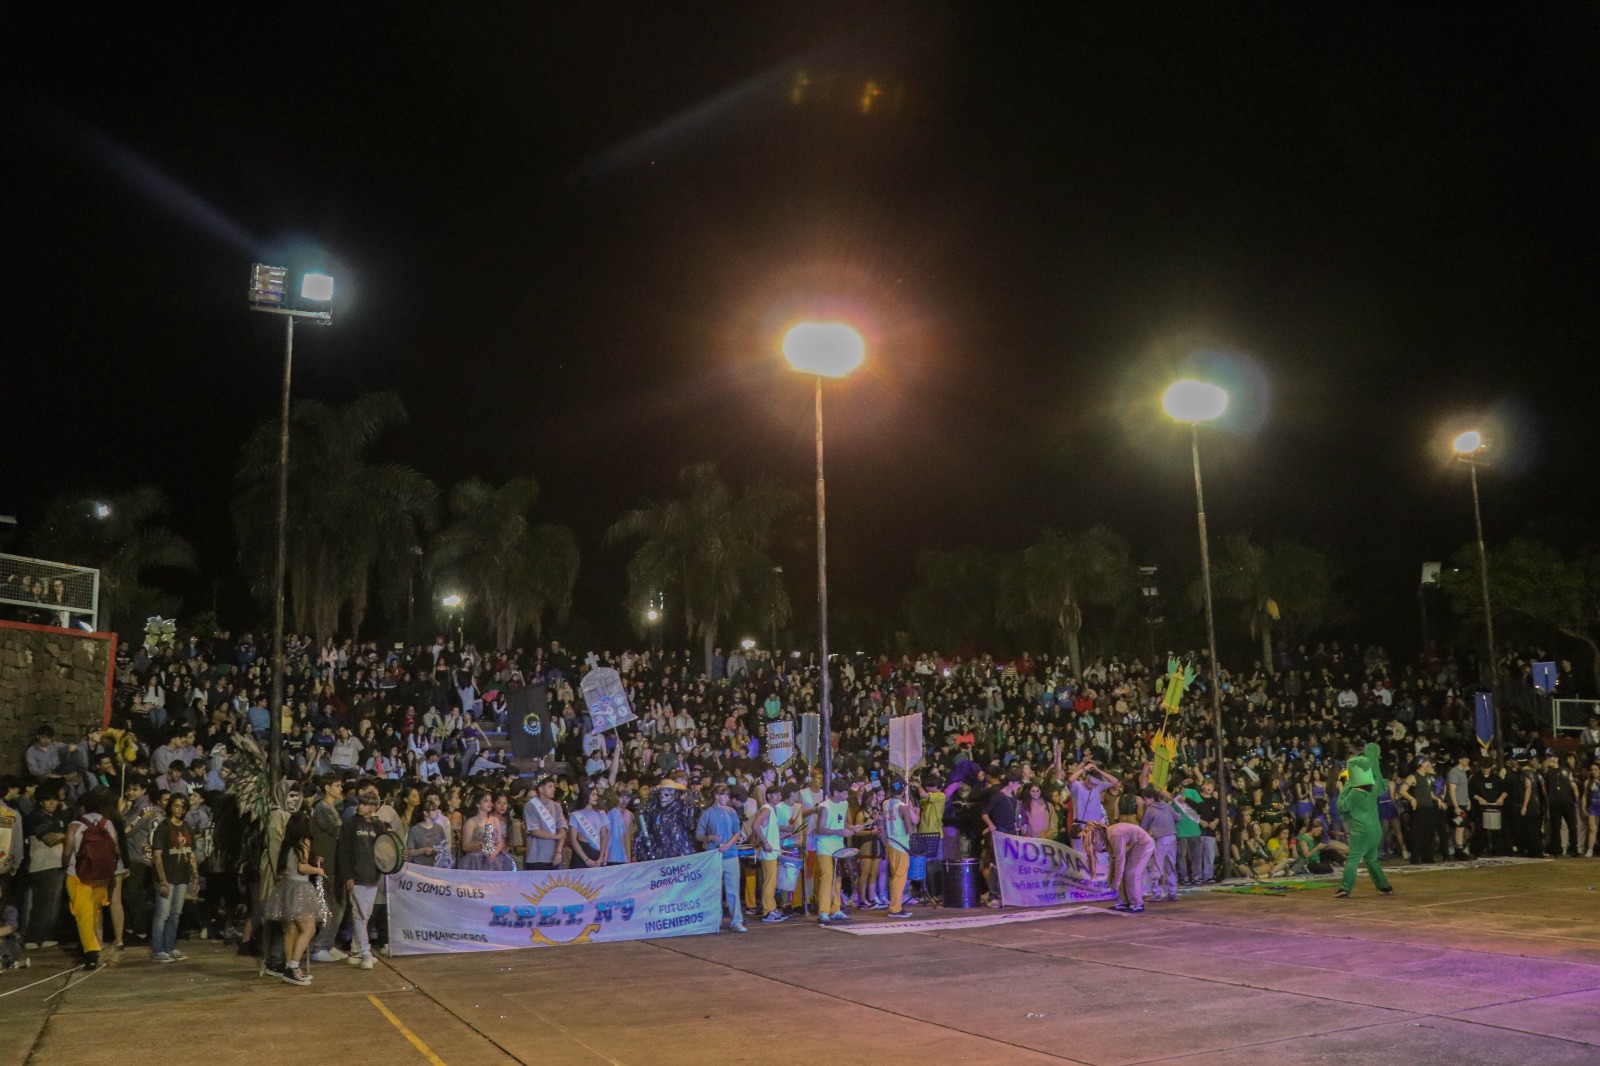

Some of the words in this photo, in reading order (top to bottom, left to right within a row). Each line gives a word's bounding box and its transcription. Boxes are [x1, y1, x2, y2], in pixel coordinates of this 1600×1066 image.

[398, 880, 413, 891] NO
[416, 882, 452, 897] SOMOS
[456, 887, 485, 899] GILES
[647, 905, 654, 916] Y
[658, 899, 701, 915] FUTUROS
[645, 912, 704, 933] INGENIEROS
[402, 929, 413, 940] NI
